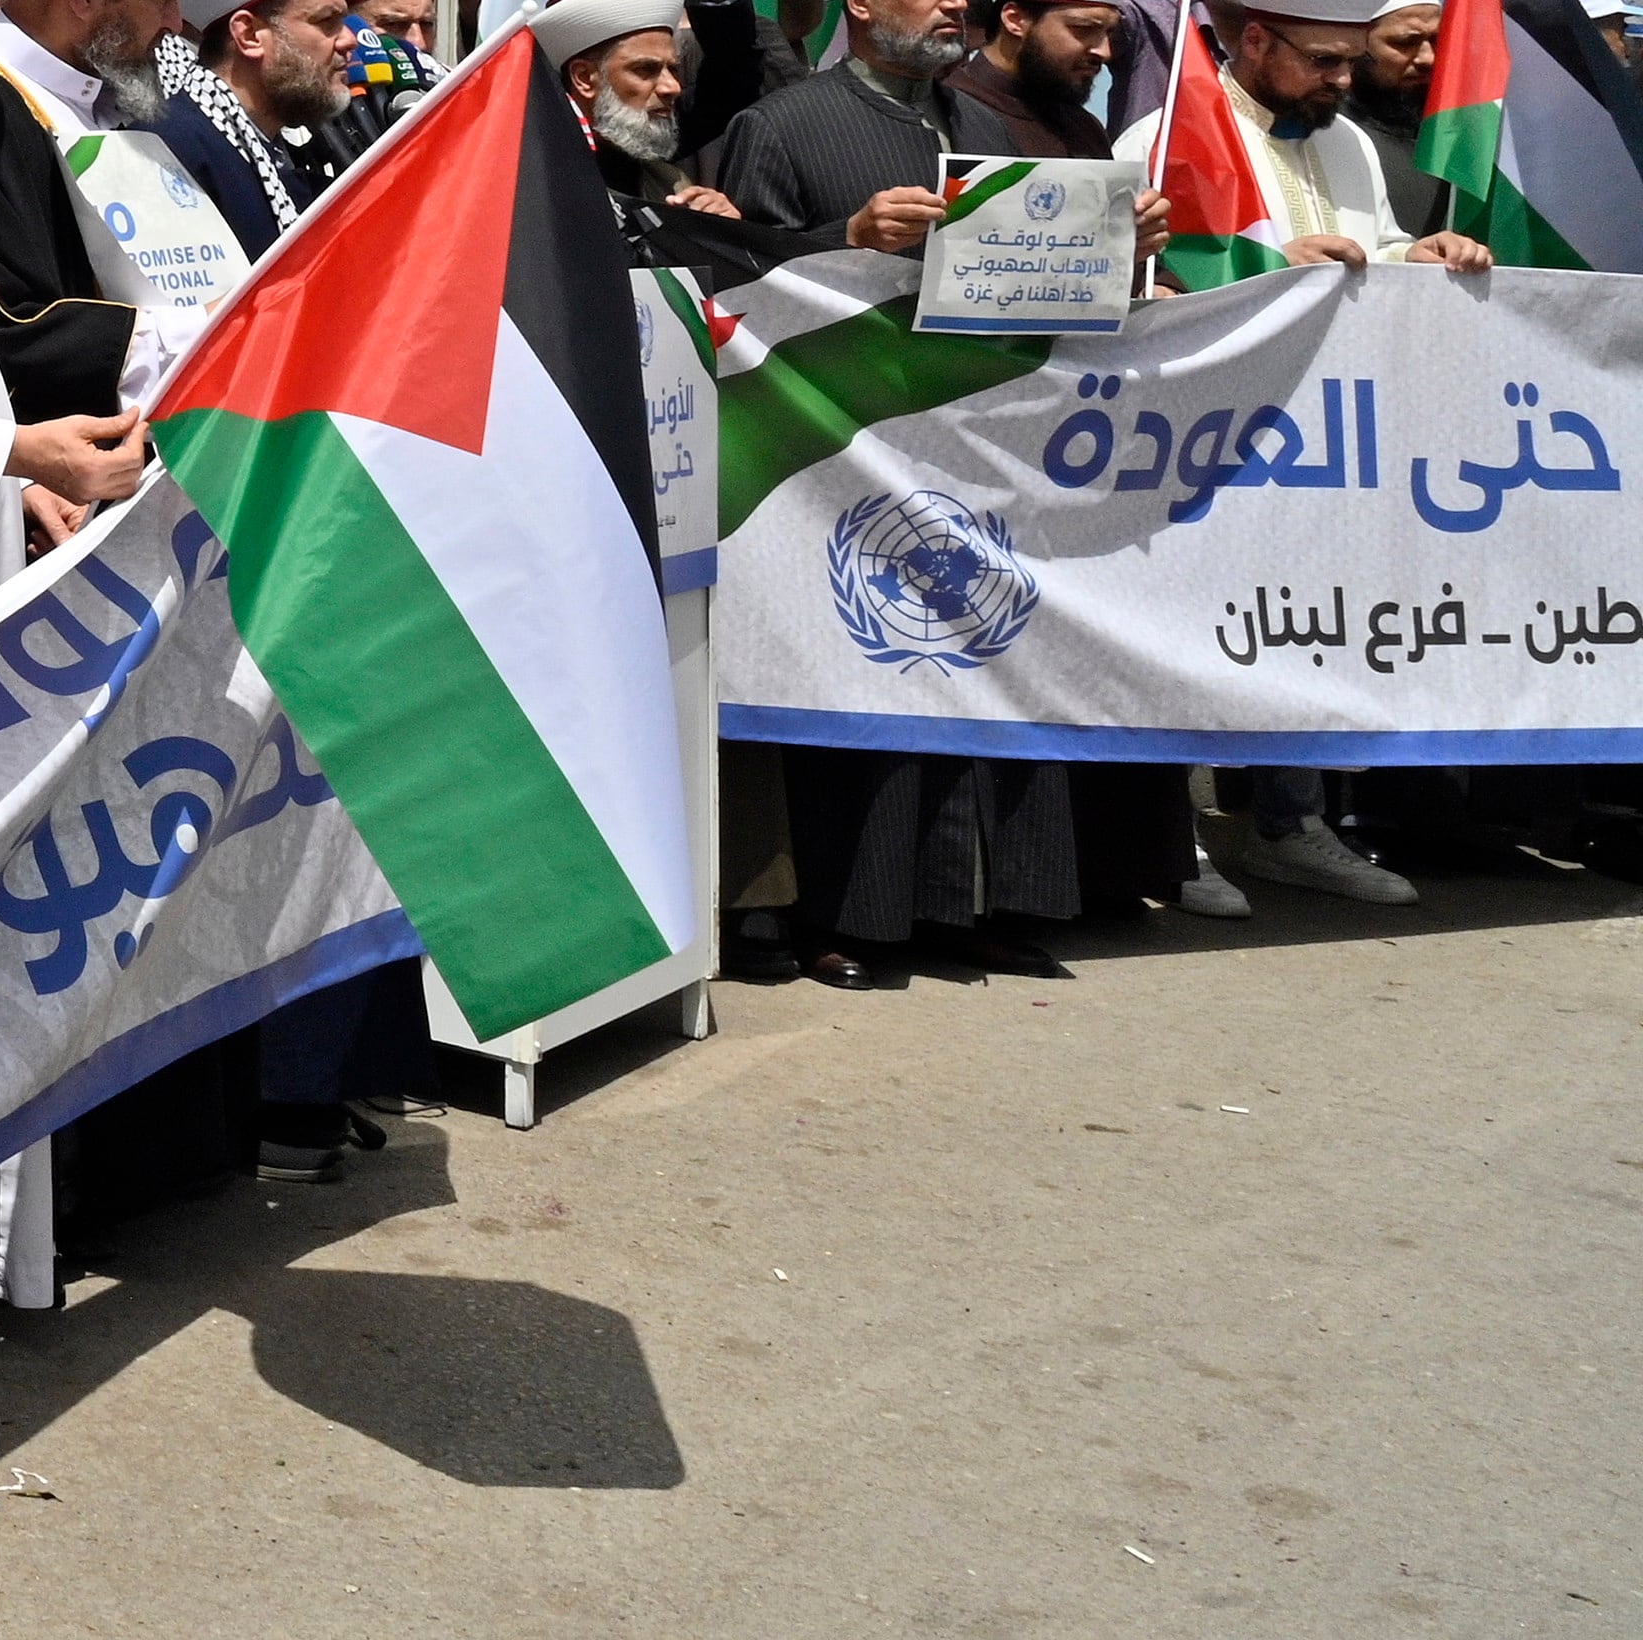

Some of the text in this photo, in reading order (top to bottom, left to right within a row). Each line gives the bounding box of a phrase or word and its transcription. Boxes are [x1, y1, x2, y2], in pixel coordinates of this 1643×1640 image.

[104, 201, 136, 242] O
[199, 243, 226, 262] ON
[977, 228, 1096, 252] ندعو لوقف
[148, 269, 215, 291] TIONAL
[953, 255, 1048, 280] الصهيوني
[964, 282, 993, 304] غزة
[996, 284, 1024, 311] في
[1068, 285, 1094, 303] ضد
[645, 376, 694, 436] الأونر
[1041, 372, 1621, 533] حتى العودة
[1215, 586, 1347, 668] لبنان
[1365, 581, 1467, 674] فرع
[1524, 586, 1643, 665] طين
